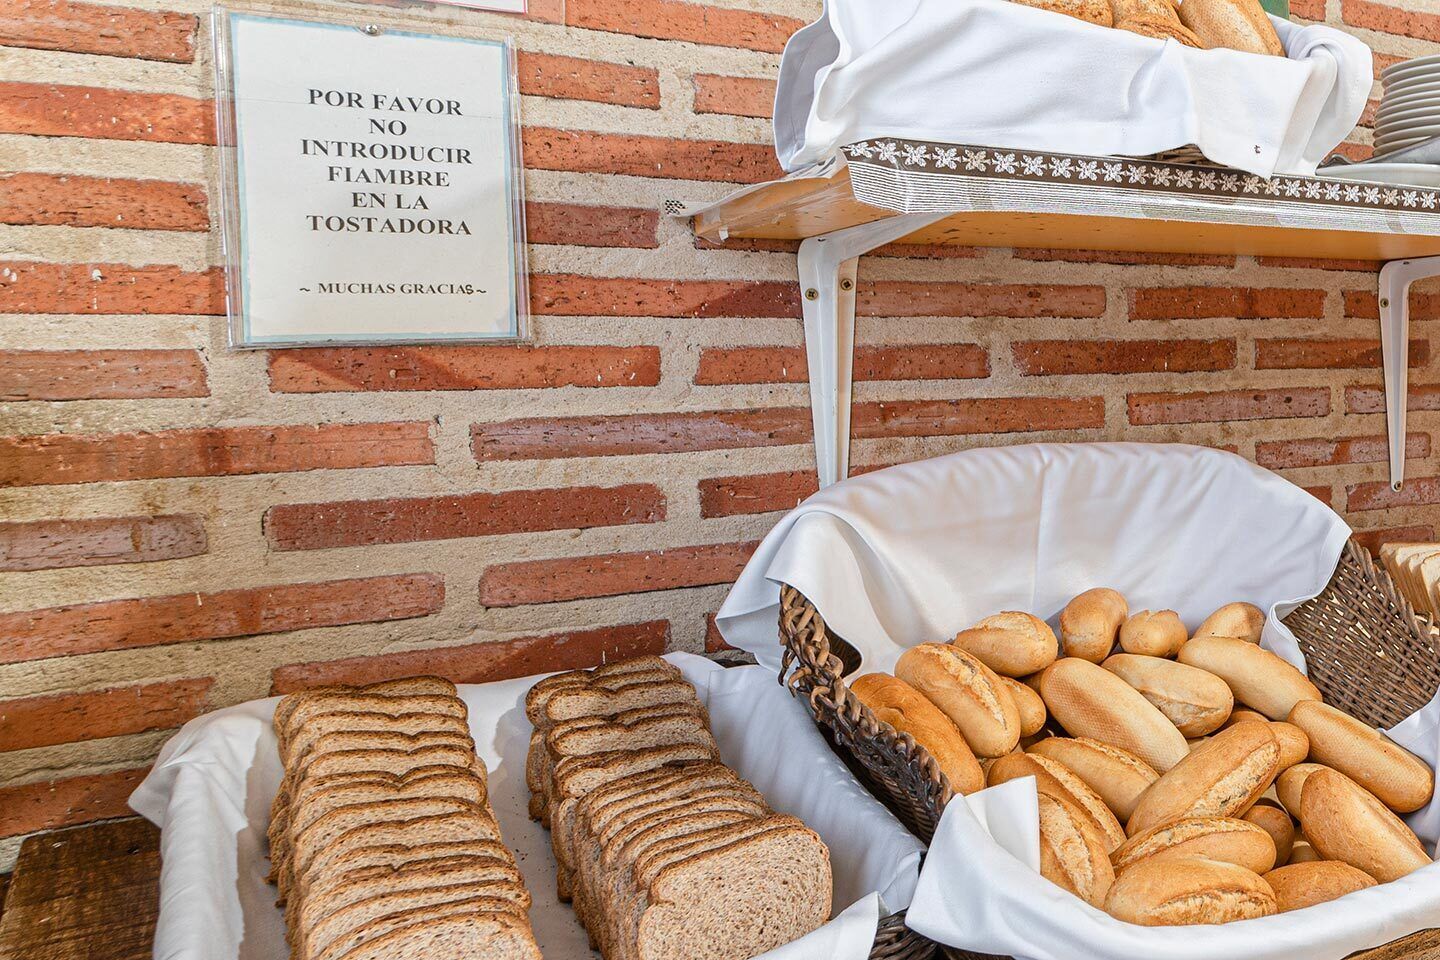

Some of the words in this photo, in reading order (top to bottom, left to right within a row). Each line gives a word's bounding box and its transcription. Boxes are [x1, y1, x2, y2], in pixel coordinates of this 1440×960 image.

[308, 89, 364, 108] POR
[372, 93, 463, 116] FAVOR
[369, 118, 407, 136] NO
[301, 139, 473, 164] INTRODUCIR
[328, 166, 450, 187] FIAMBRE
[352, 192, 386, 208] EN
[395, 194, 429, 210] LA
[306, 215, 472, 235] TOSTADORA
[318, 282, 396, 295] MUCHAS
